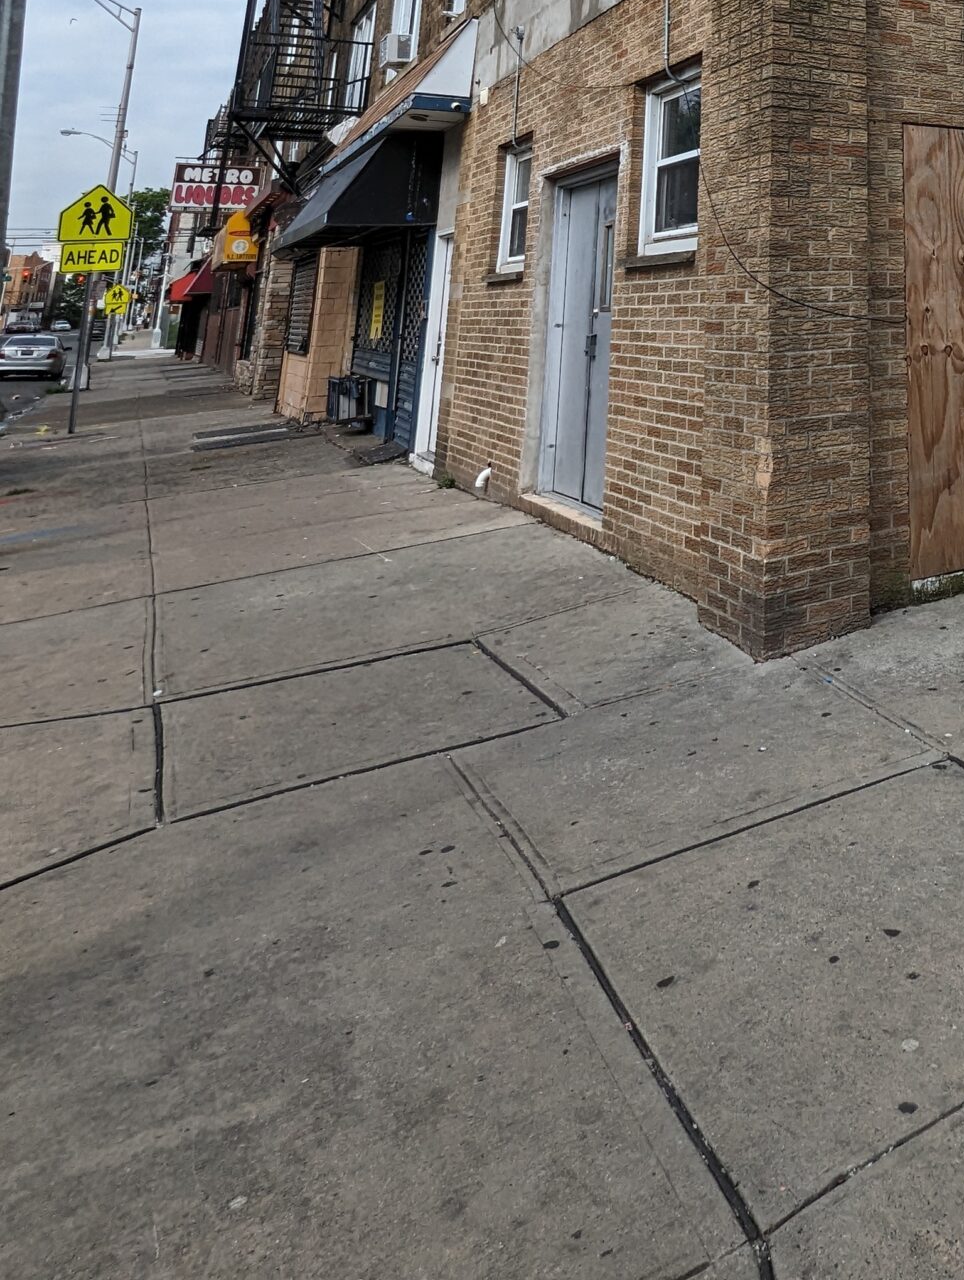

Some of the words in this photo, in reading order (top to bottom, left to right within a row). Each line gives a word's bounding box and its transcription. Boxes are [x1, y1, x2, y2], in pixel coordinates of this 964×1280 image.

[183, 167, 254, 184] METRO
[174, 185, 256, 206] LIQUORS
[64, 249, 120, 266] AHEAD
